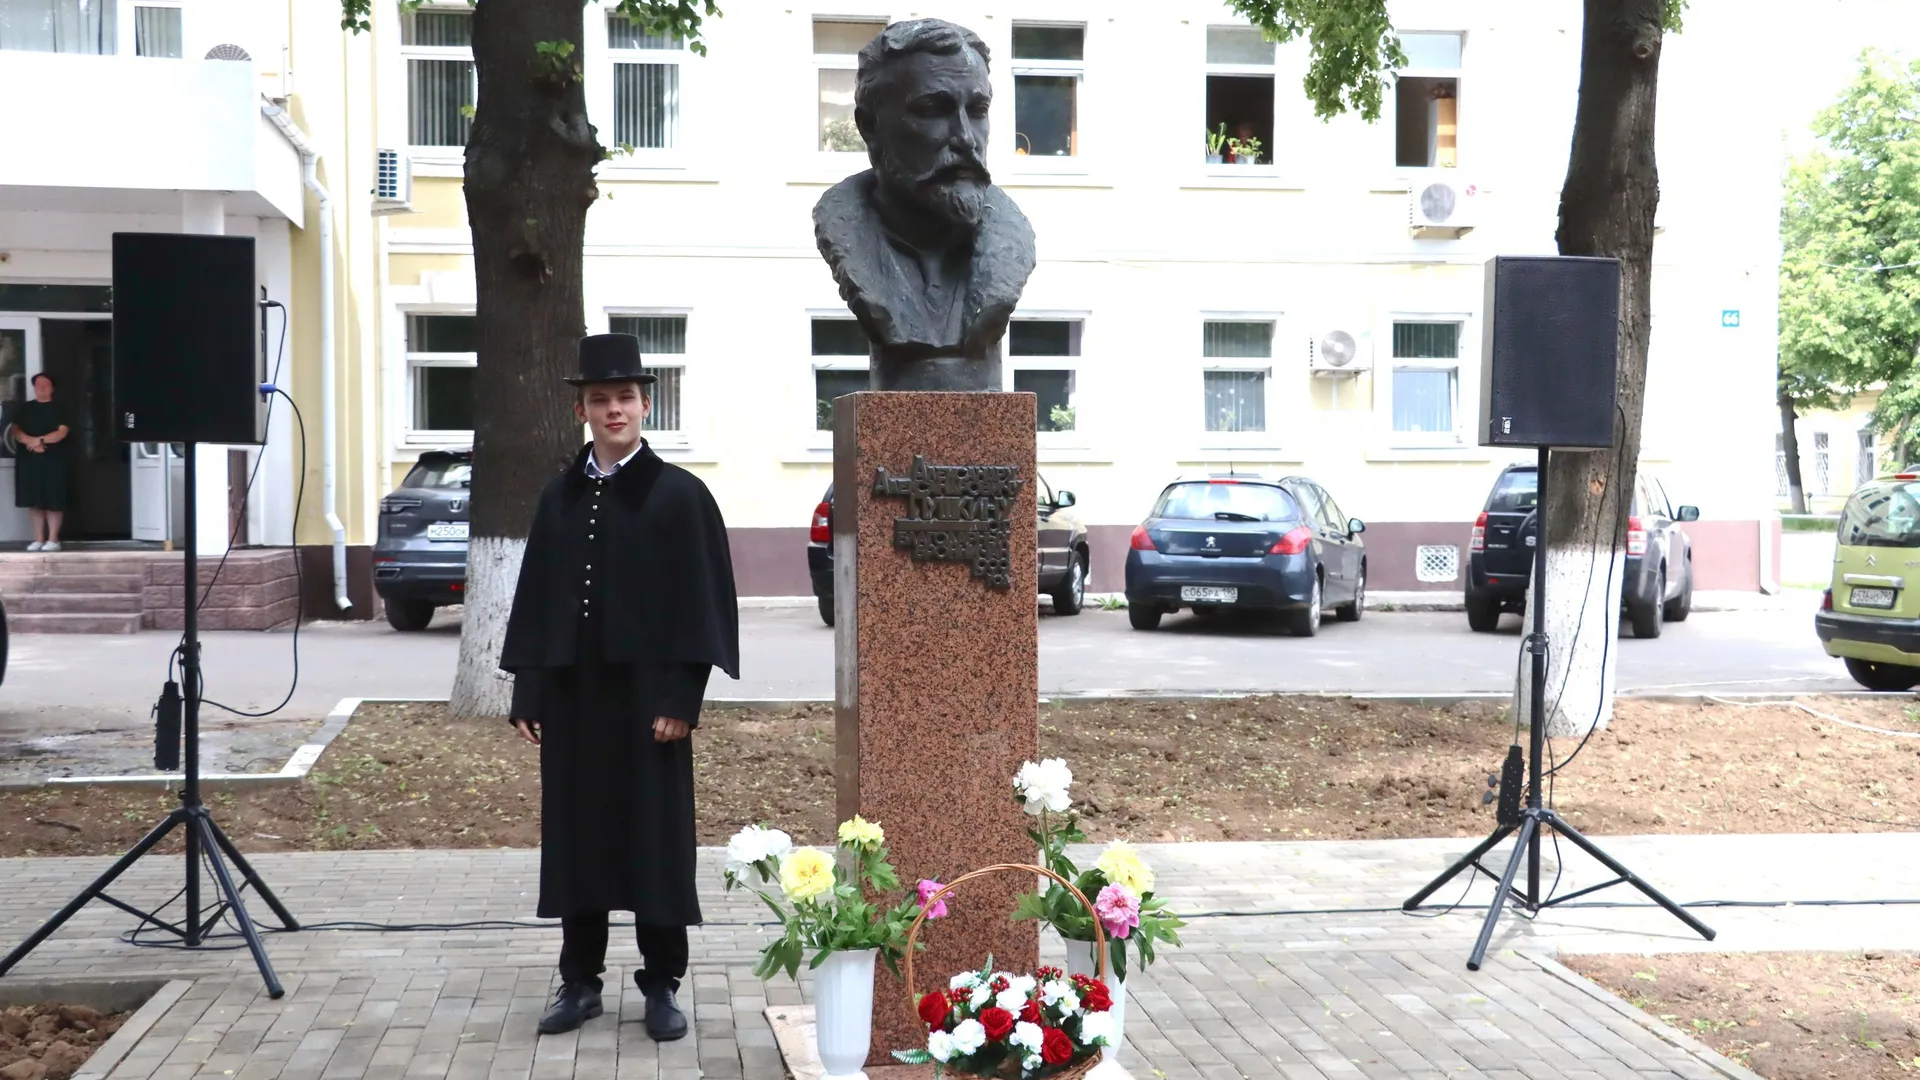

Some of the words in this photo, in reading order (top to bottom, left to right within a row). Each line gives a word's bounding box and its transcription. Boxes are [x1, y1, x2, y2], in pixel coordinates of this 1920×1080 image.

[1723, 311, 1739, 325] 66
[909, 493, 1017, 520] ПУШКИНУ
[988, 519, 1011, 532] ОТ
[896, 530, 1011, 546] БЛАГОДАРНЫХ
[914, 544, 1011, 560] БРОННИЧАН
